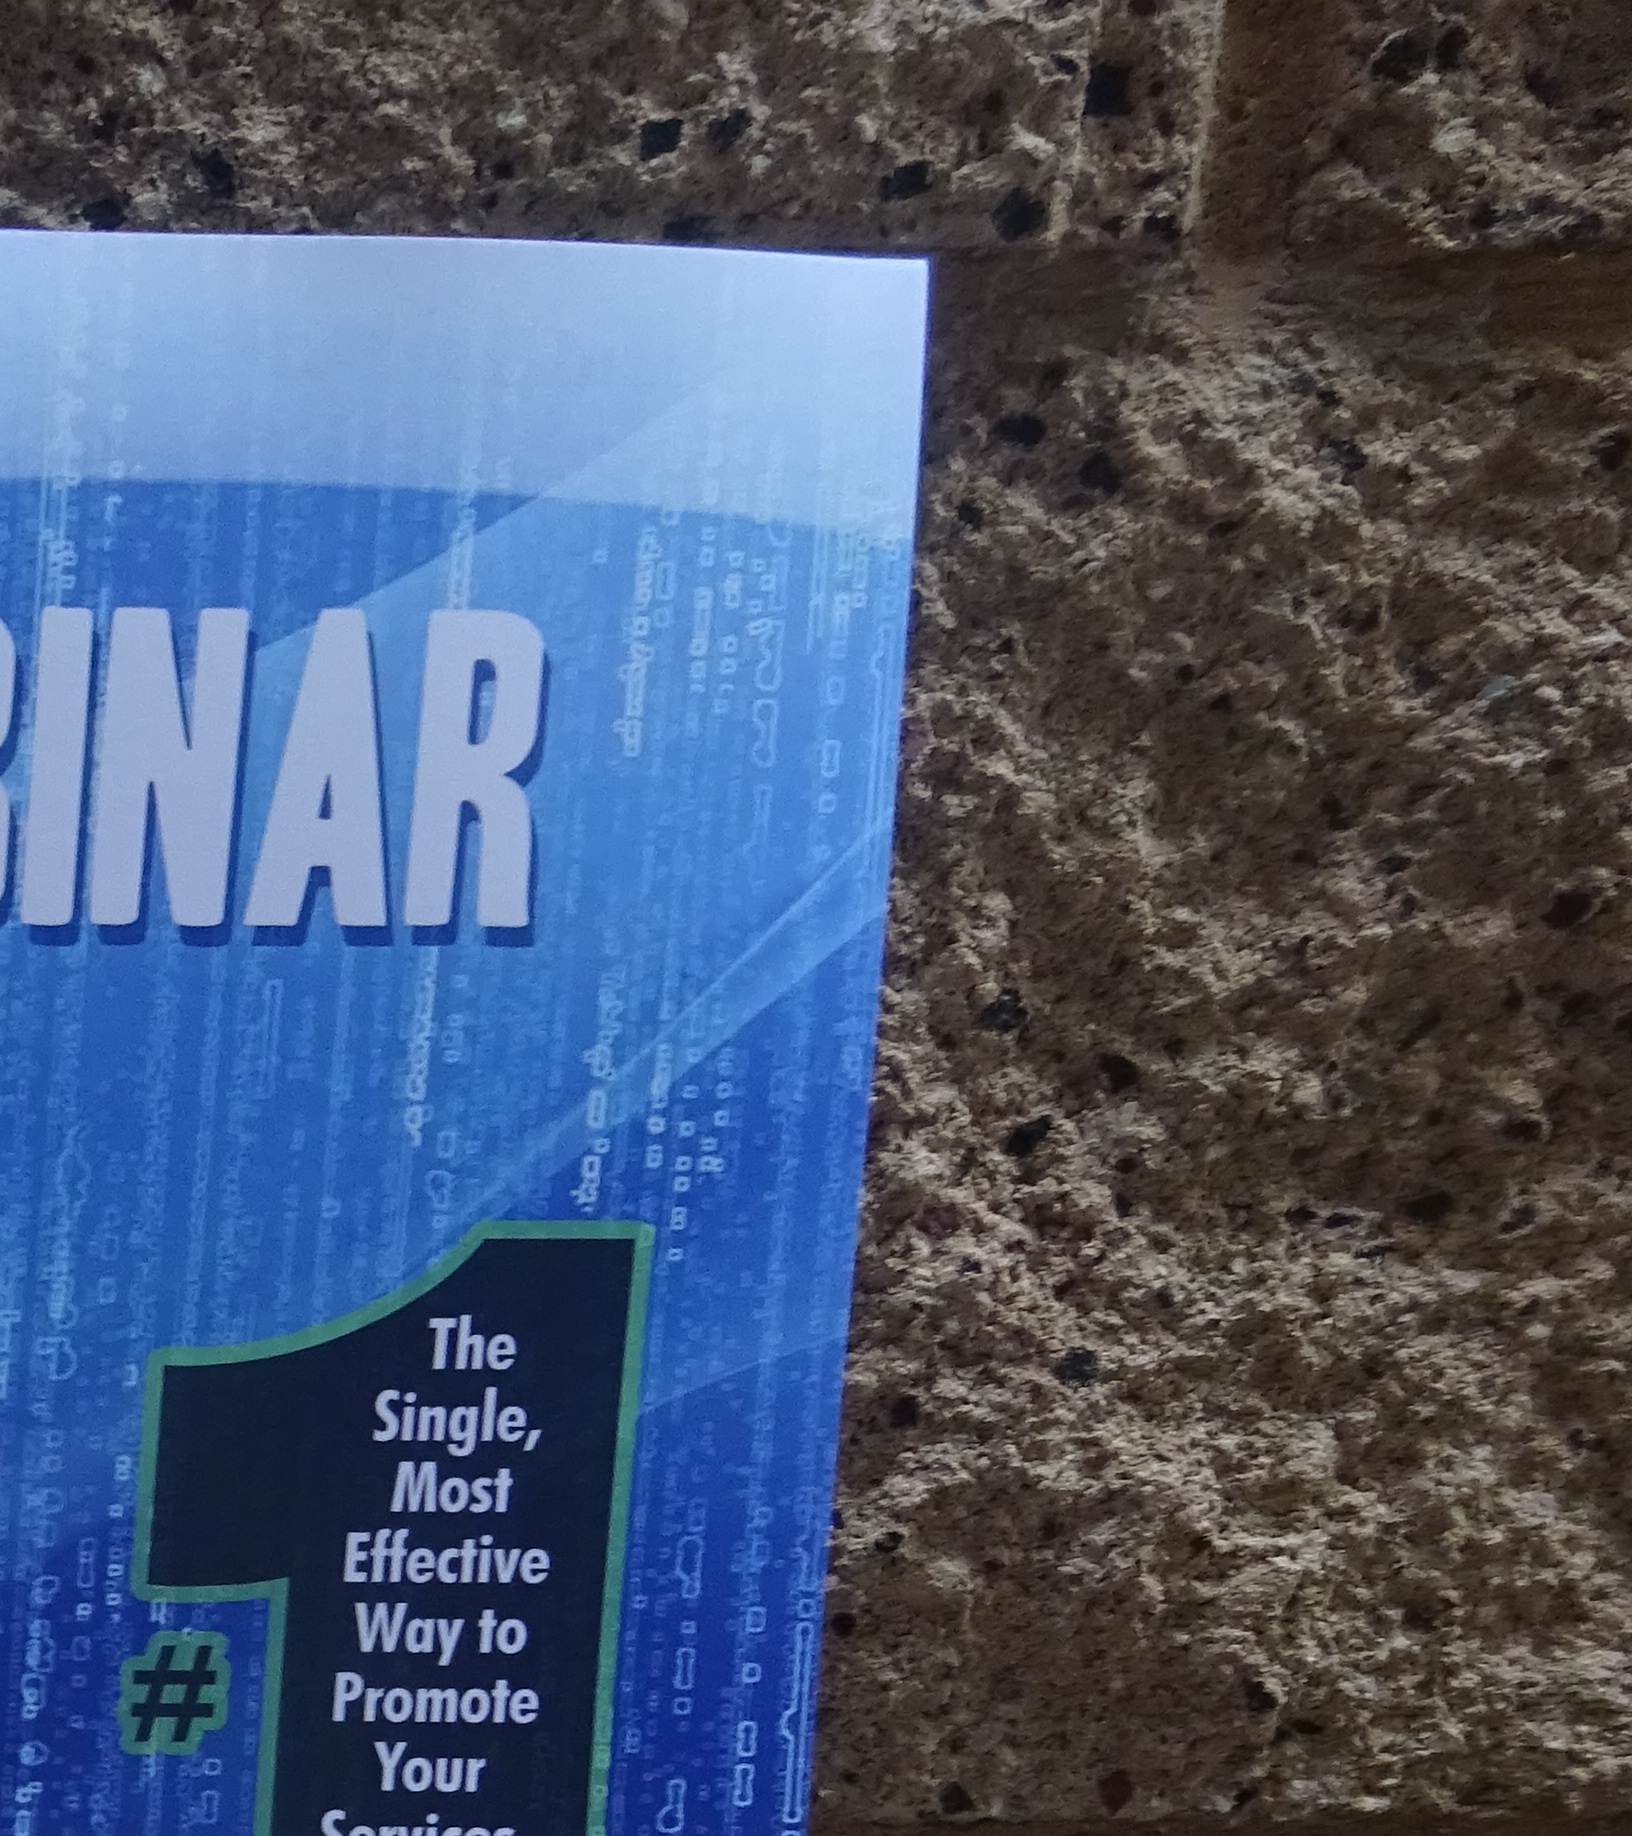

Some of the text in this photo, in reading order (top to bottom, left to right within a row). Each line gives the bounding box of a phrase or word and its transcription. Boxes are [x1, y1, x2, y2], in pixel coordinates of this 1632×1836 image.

[429, 1316, 517, 1370] The
[372, 1390, 542, 1456] Single,
[389, 1461, 513, 1514] Most
[343, 1531, 551, 1585] Effective
[355, 1603, 528, 1666] Way to
[331, 1672, 540, 1725] Promote
[374, 1742, 487, 1794] Your
